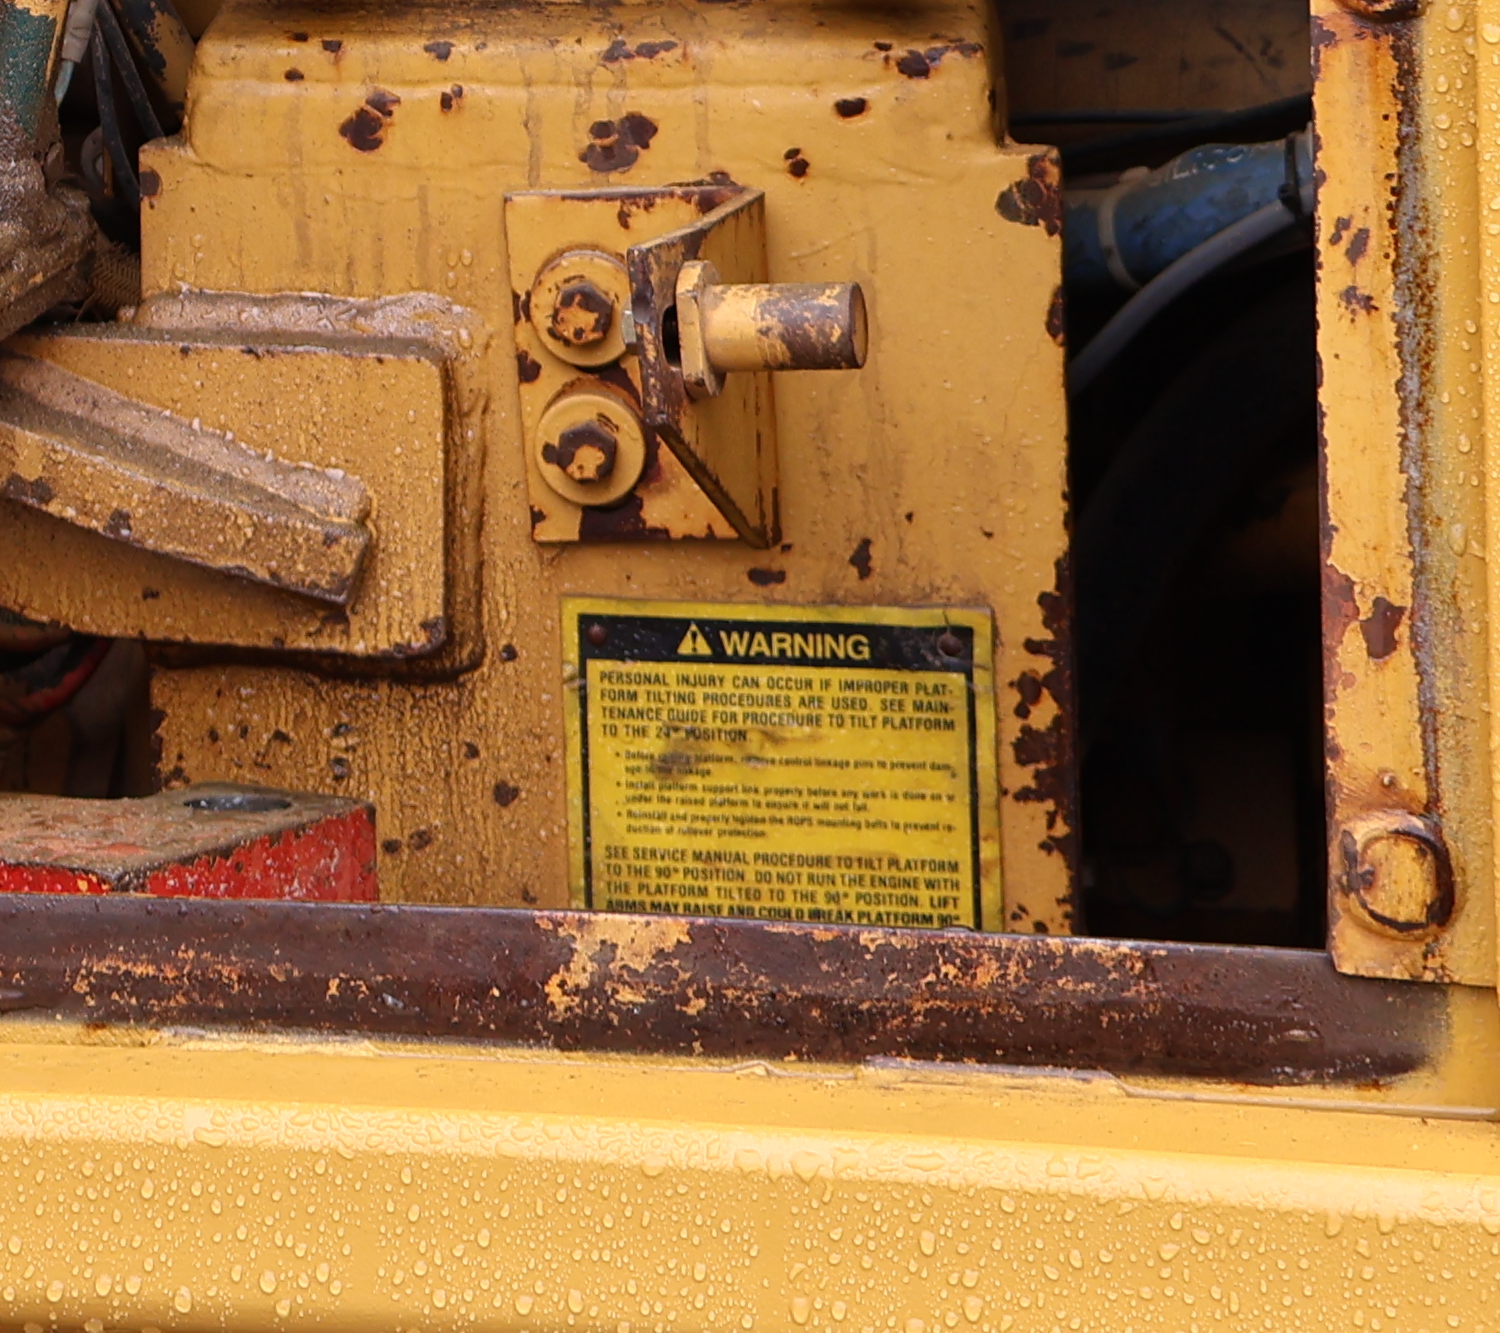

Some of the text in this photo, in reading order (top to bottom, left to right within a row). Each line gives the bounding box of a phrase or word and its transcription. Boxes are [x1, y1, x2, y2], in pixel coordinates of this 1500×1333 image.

[719, 630, 871, 661] WARNING
[599, 670, 954, 696] PERSONAL INJURY CAN OCCUR IF IMPROPER PLAT-
[600, 689, 955, 714] FORM TILTING PROCEDURES ARE USED. SEE MAIN-
[601, 707, 955, 732] TENANCE GUIDE FOR PROCEDURE TO TILT PLATFORM
[602, 724, 617, 737] TO
[624, 724, 649, 739] THE
[605, 844, 959, 873] SEE SERVICE MANUAL PROCEDURE TO TILT PLATFORM
[606, 862, 622, 877] TO
[626, 864, 651, 878] THE
[754, 870, 773, 884] DO
[776, 871, 803, 884] NOT
[807, 872, 836, 886] RUN
[839, 873, 866, 887] THE
[870, 874, 920, 890] ENGINE
[924, 877, 961, 891] WITH
[606, 881, 631, 895] THE
[638, 882, 708, 898] PLATFORM
[715, 886, 761, 901] TILTED
[769, 888, 785, 902] TO
[793, 889, 818, 903] THE
[930, 894, 960, 910] LIFT
[606, 899, 647, 912] ARMS
[650, 900, 680, 913] MAY
[758, 906, 804, 921] COULD
[857, 909, 934, 926] PLATFORM
